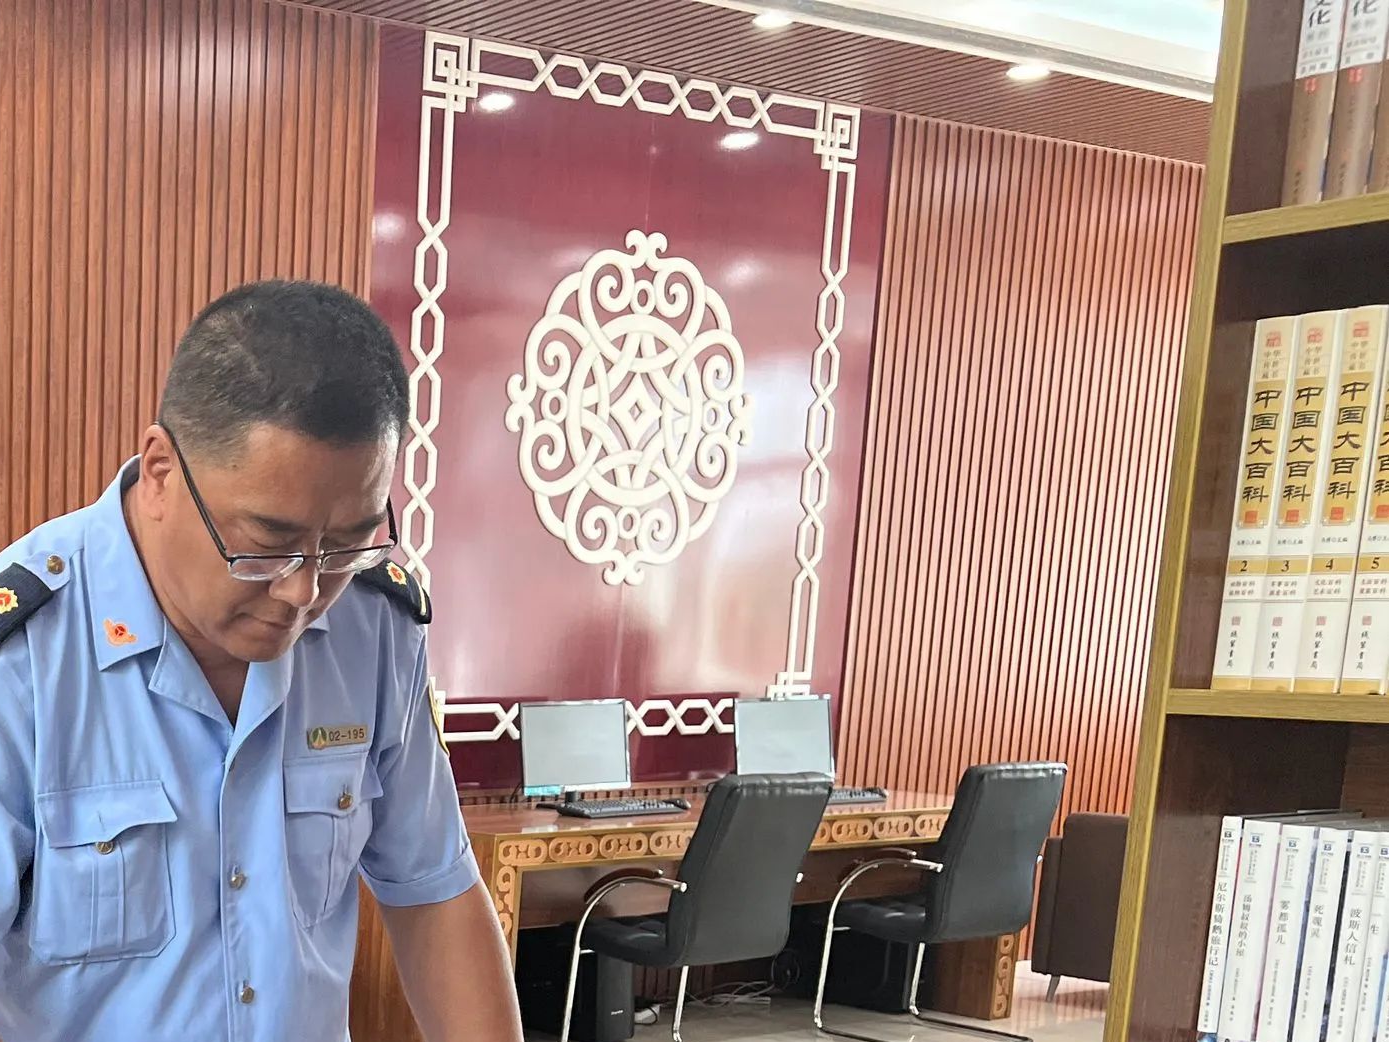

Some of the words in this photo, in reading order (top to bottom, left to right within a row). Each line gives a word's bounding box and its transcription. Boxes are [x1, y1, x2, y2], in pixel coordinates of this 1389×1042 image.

[1243, 390, 1283, 503] 中国大百科
[1283, 387, 1324, 503] 中国大百科
[1327, 382, 1370, 500] 中国大百科
[1240, 560, 1248, 572] 2
[1281, 560, 1290, 572] 3
[1325, 558, 1334, 570] 4
[1371, 557, 1380, 569] 5
[328, 728, 365, 742] 02-195
[1208, 881, 1228, 967] 尼尔斯骑鹅旅行记
[1236, 894, 1252, 956] 汤姆叔叔的小屋
[1275, 900, 1290, 945] 雾都孤儿
[1310, 904, 1324, 938] 死魂灵
[1343, 908, 1362, 967] 波斯人信札
